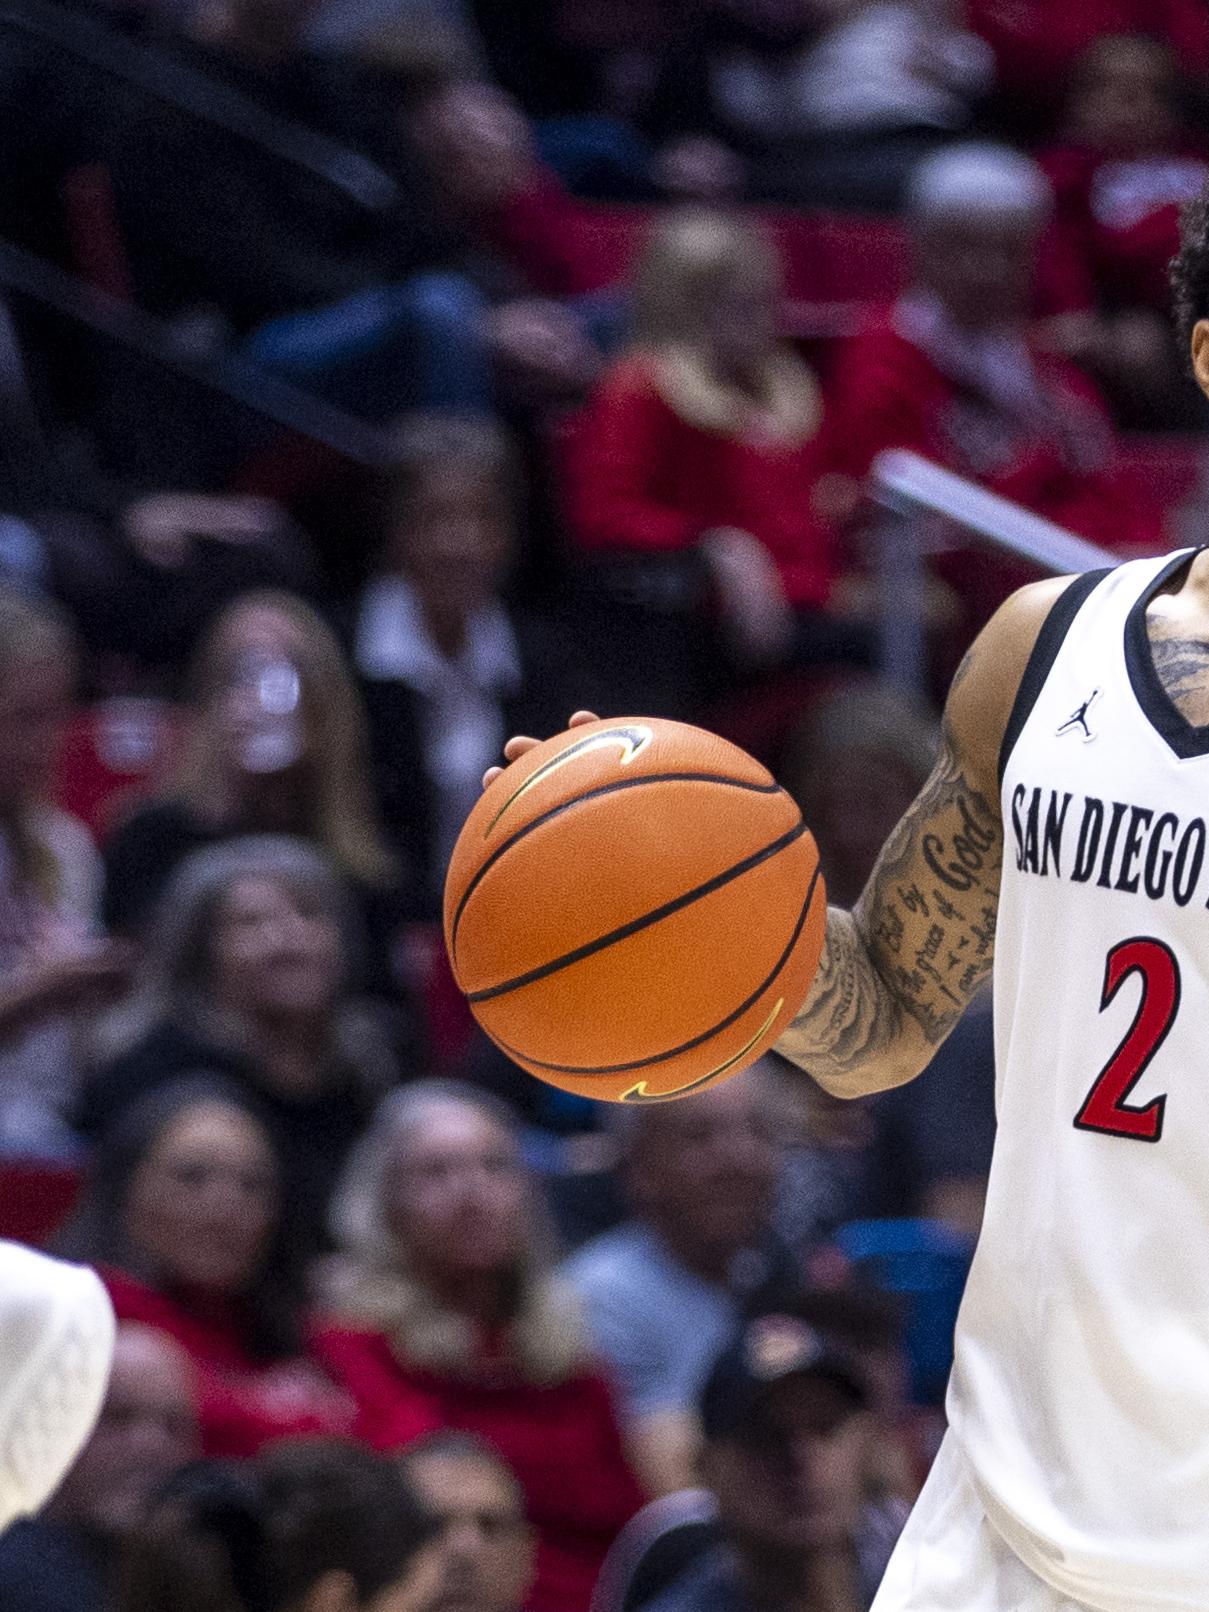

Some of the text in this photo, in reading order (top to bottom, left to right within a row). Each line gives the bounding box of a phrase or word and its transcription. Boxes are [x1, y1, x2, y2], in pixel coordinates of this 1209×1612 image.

[922, 796, 996, 891] God
[1011, 783, 1073, 878] SAN
[1070, 796, 1206, 907] DIEGO
[897, 883, 929, 917] by
[1073, 935, 1182, 1143] 2
